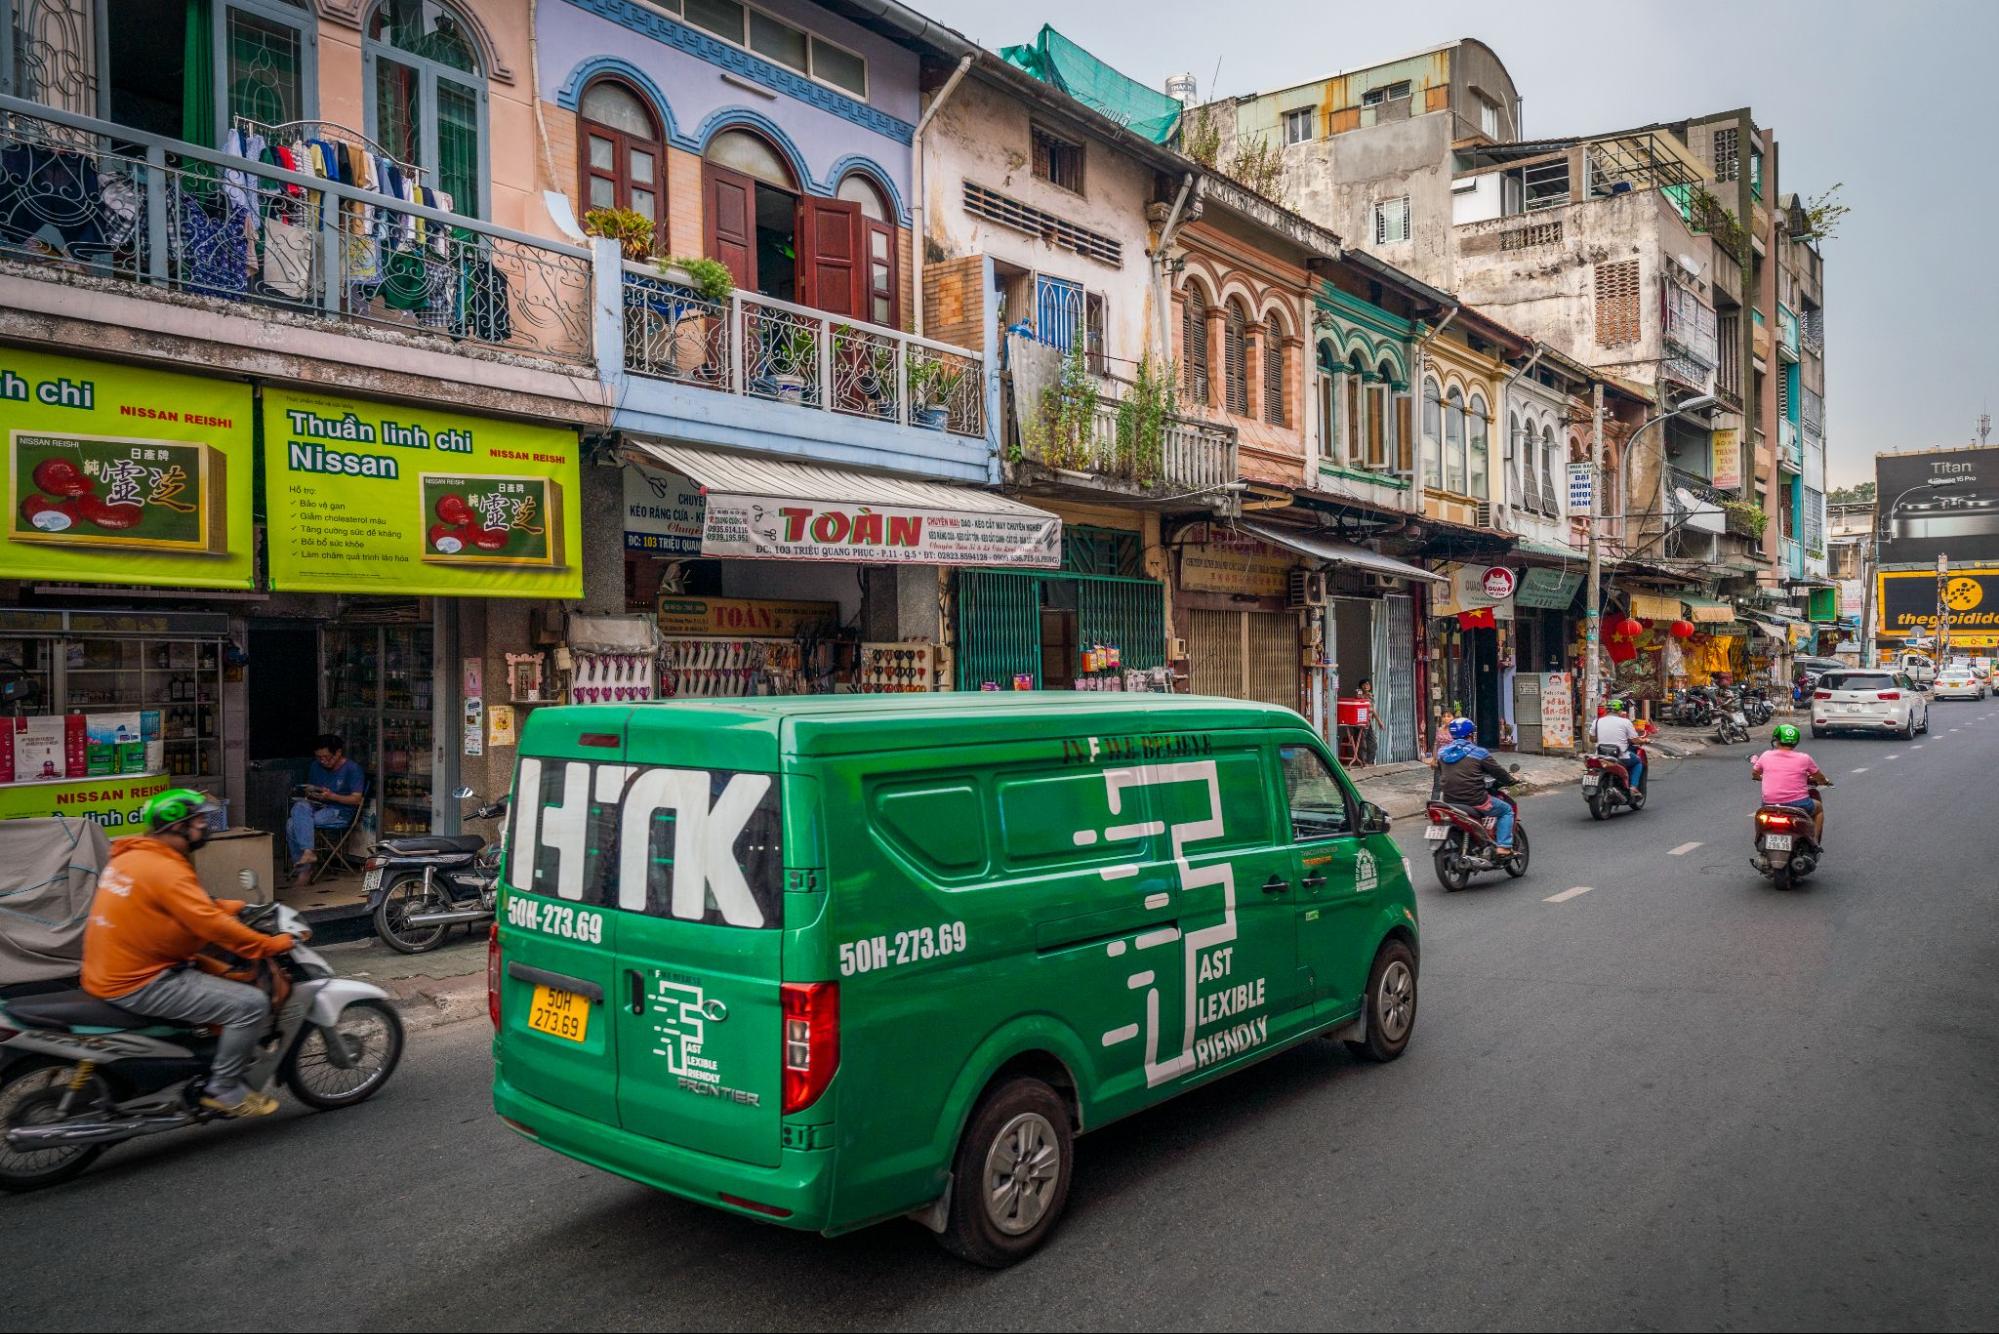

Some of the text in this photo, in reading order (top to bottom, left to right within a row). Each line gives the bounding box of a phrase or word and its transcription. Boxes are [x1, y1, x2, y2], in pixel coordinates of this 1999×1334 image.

[0, 371, 93, 409] h chi
[121, 406, 232, 428] NISSAN REISHI
[20, 438, 79, 448] NISSAN REISHI
[288, 409, 472, 453] Thuần linh chi
[288, 441, 398, 479] Nissan
[490, 449, 565, 464] NISSAN REISHI
[1930, 462, 1972, 474] Titan
[630, 504, 647, 517] KÉO
[779, 507, 922, 547] TOÀN
[643, 536, 657, 548] 103
[682, 539, 702, 552] QUAN
[775, 545, 791, 554] 103
[822, 547, 850, 557] QUANG
[714, 602, 771, 628] TOÀN
[57, 788, 124, 805] NISSAN
[508, 896, 603, 944] 50H-273.69
[838, 920, 967, 977] 50H-273.69
[1198, 947, 1233, 984] AST
[547, 987, 572, 1012] 50H
[1198, 977, 1266, 1027] LEXIBLE
[535, 1008, 579, 1038] 273.69
[1194, 1016, 1268, 1069] RIENDLY
[687, 1056, 718, 1070] LEXIBLE
[687, 1068, 720, 1084] RIENDLY
[678, 1077, 761, 1107] FRONTIER
